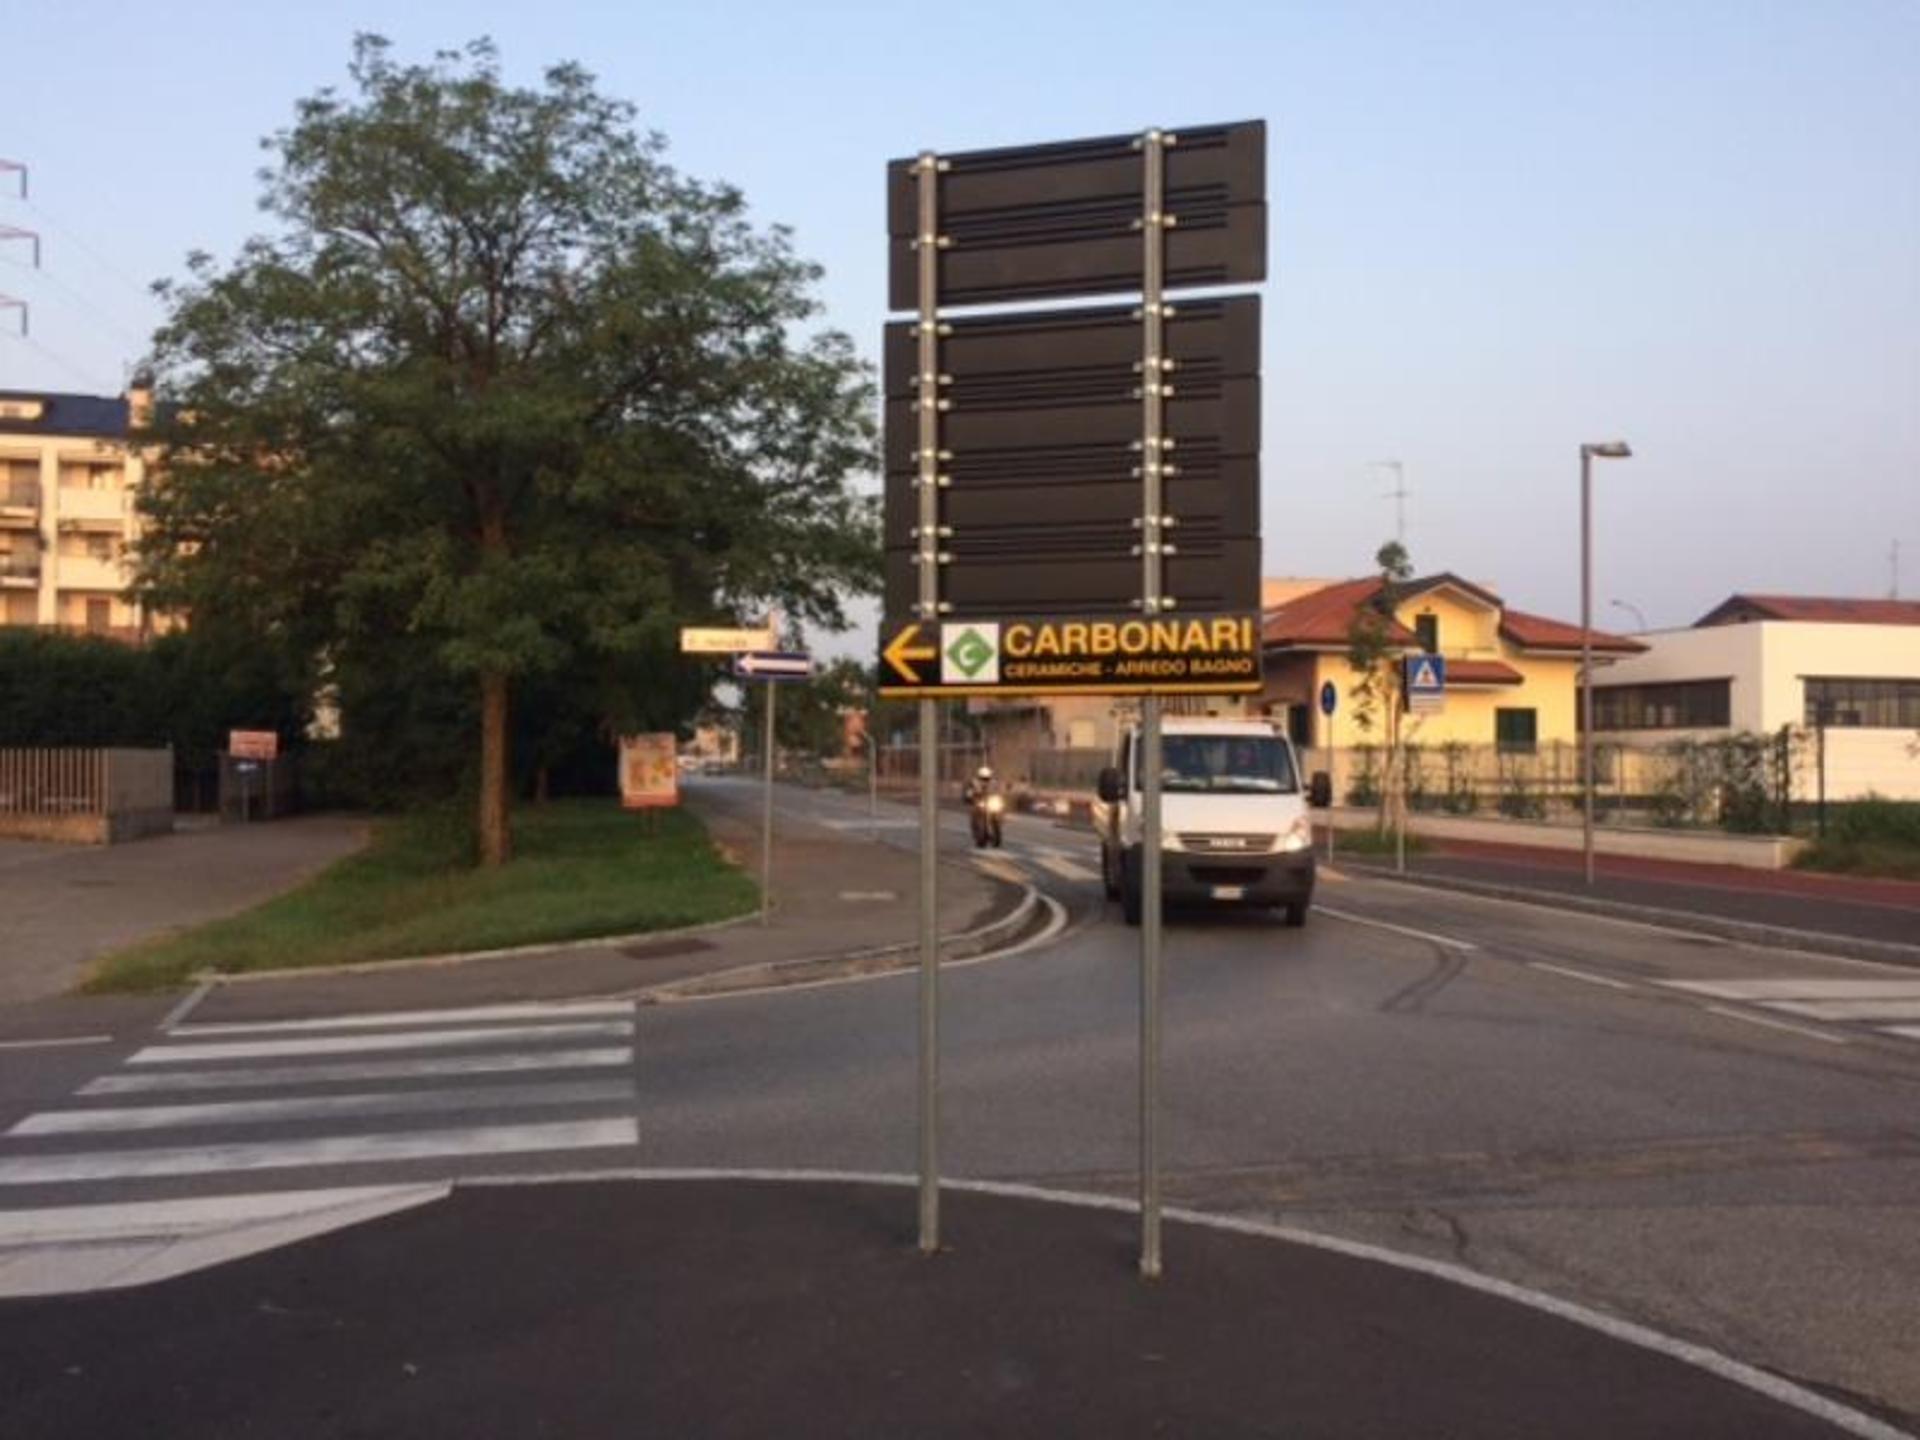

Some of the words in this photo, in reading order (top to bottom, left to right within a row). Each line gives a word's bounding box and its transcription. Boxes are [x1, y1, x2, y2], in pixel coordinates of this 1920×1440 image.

[1005, 619, 1252, 656] CARBONARI
[1004, 661, 1101, 679] CERAMICHE
[1115, 659, 1187, 676] ARREDO
[1190, 658, 1252, 674] BAGNO
